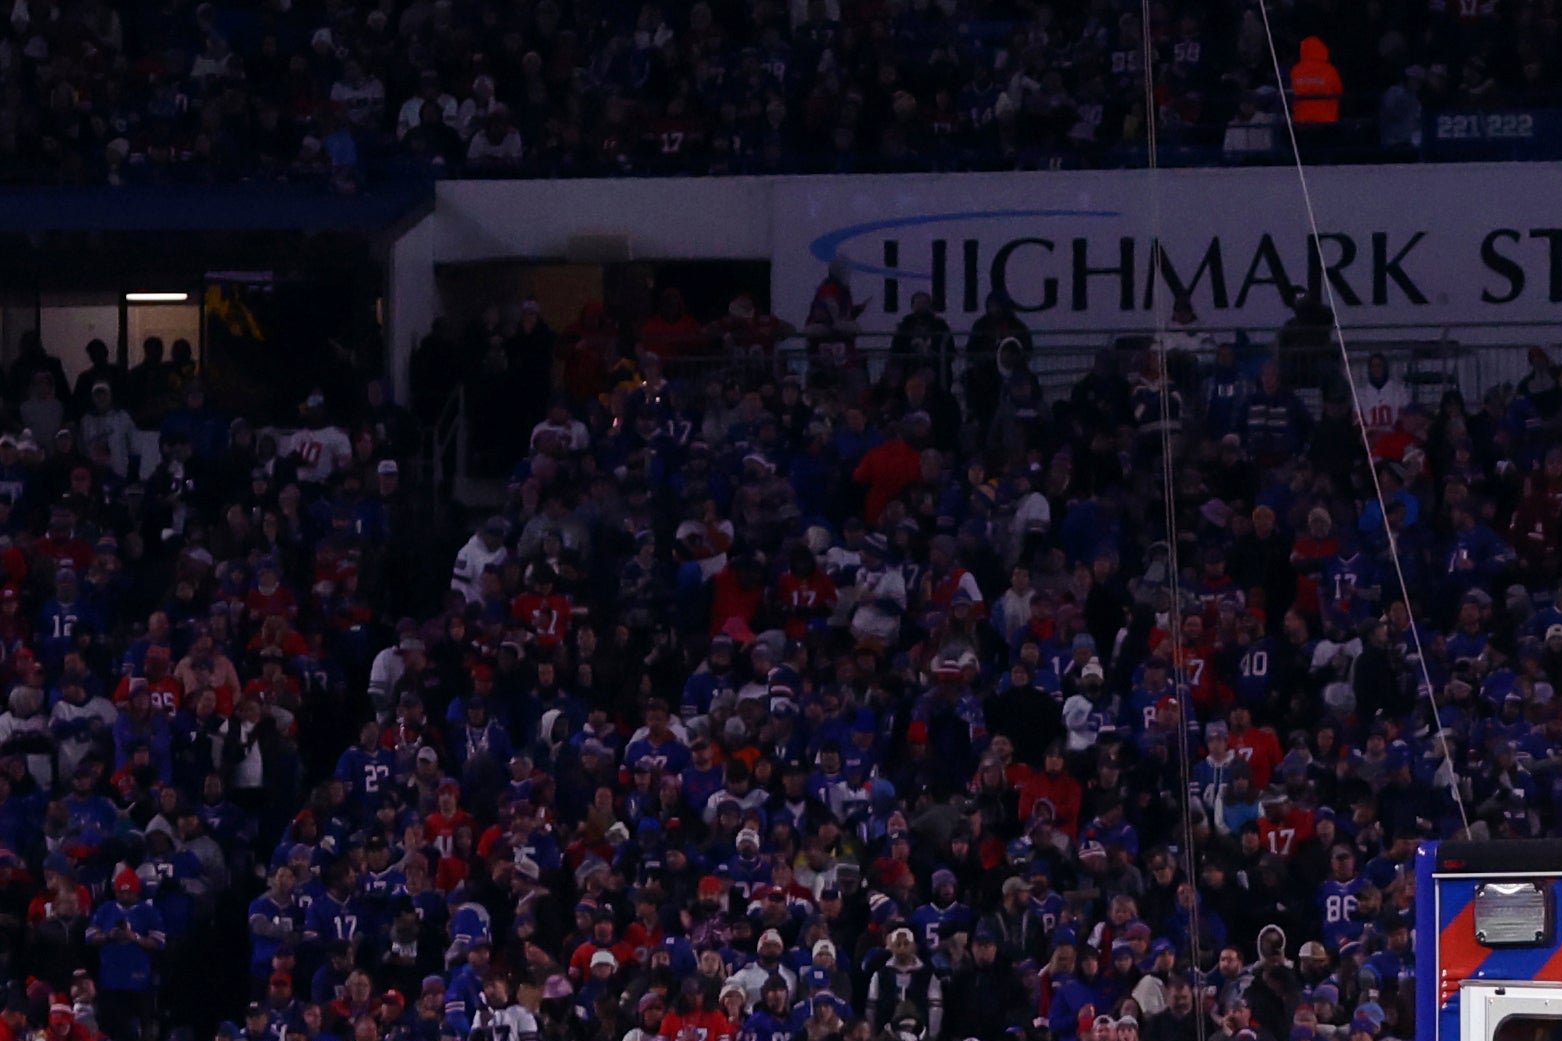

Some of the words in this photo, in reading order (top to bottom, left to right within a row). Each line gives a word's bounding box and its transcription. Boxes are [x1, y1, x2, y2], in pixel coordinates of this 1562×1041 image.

[1438, 115, 1480, 138] 221
[1487, 114, 1533, 137] 222
[662, 132, 683, 153] 17
[883, 230, 1432, 314] HIGHMARK
[667, 420, 692, 444] 17
[1240, 652, 1267, 675] 40
[1267, 829, 1295, 854] 17
[334, 915, 356, 939] 17
